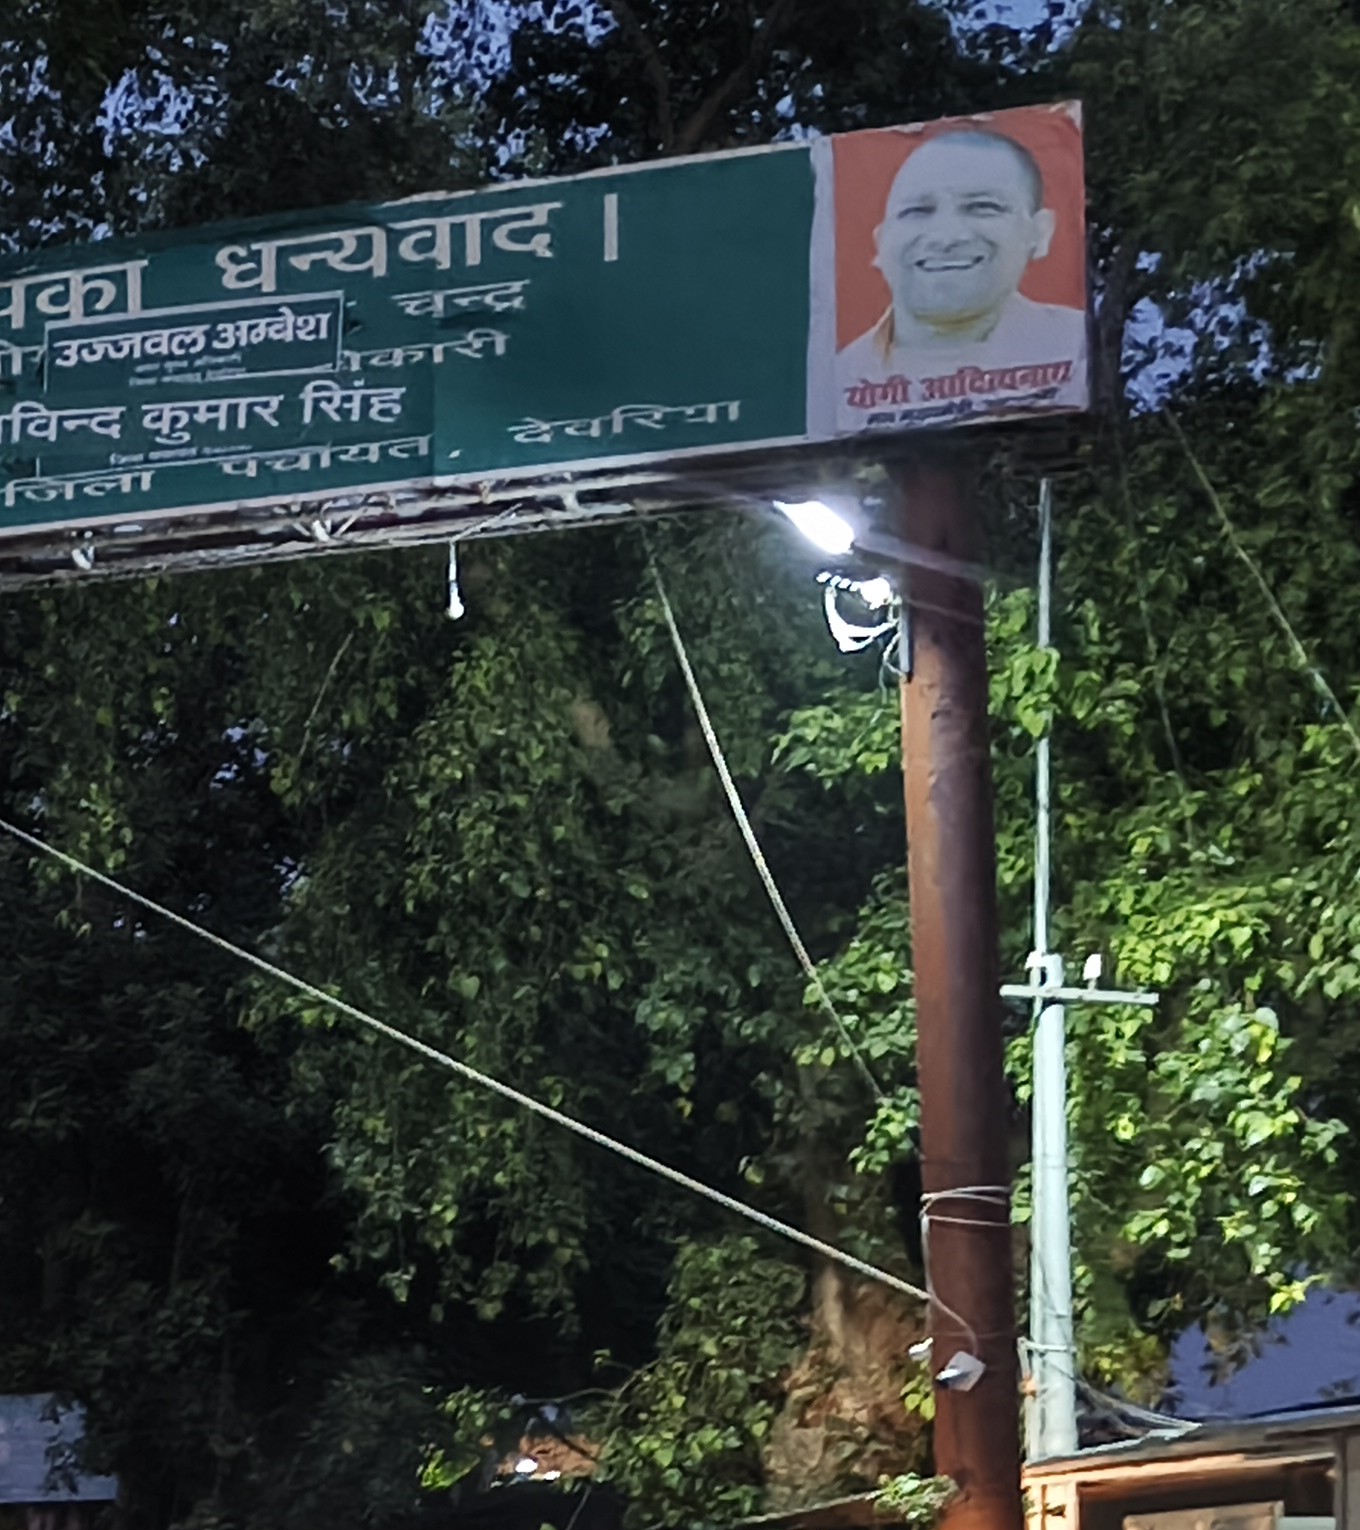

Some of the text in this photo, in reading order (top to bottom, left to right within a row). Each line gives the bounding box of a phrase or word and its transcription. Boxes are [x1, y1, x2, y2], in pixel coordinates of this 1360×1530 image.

[215, 201, 563, 292] धन्यवाद
[140, 394, 285, 445] कुमार
[300, 377, 408, 424] सिंह
